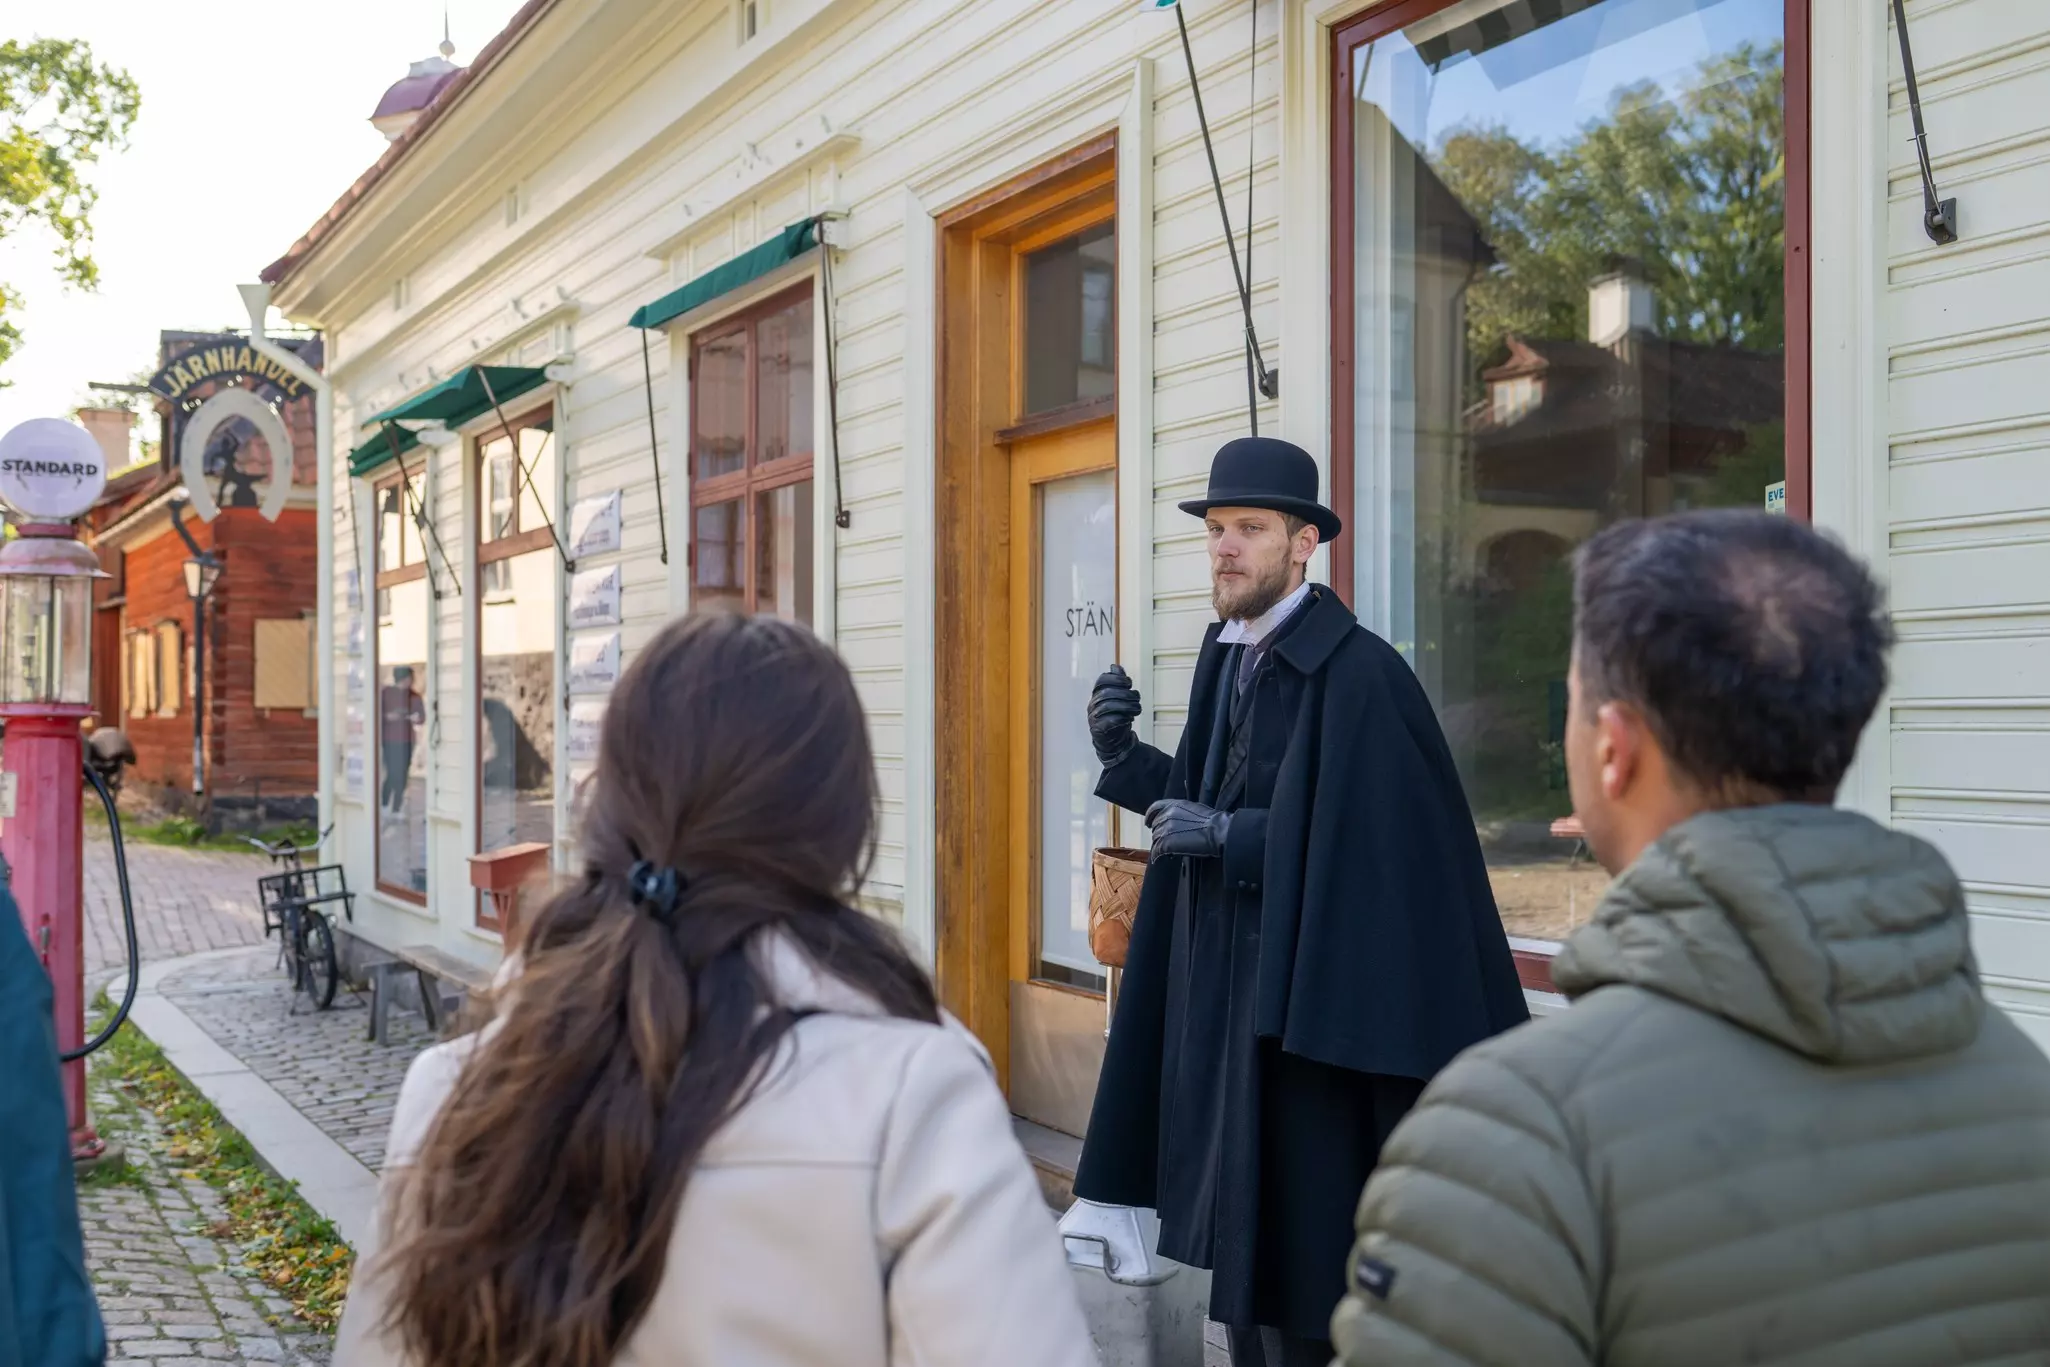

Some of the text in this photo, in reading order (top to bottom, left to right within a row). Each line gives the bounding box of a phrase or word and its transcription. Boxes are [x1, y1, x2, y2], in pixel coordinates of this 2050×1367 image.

[2, 459, 98, 475] STANDARD
[1768, 487, 1784, 502] EVE
[1065, 600, 1114, 638] STÄN
